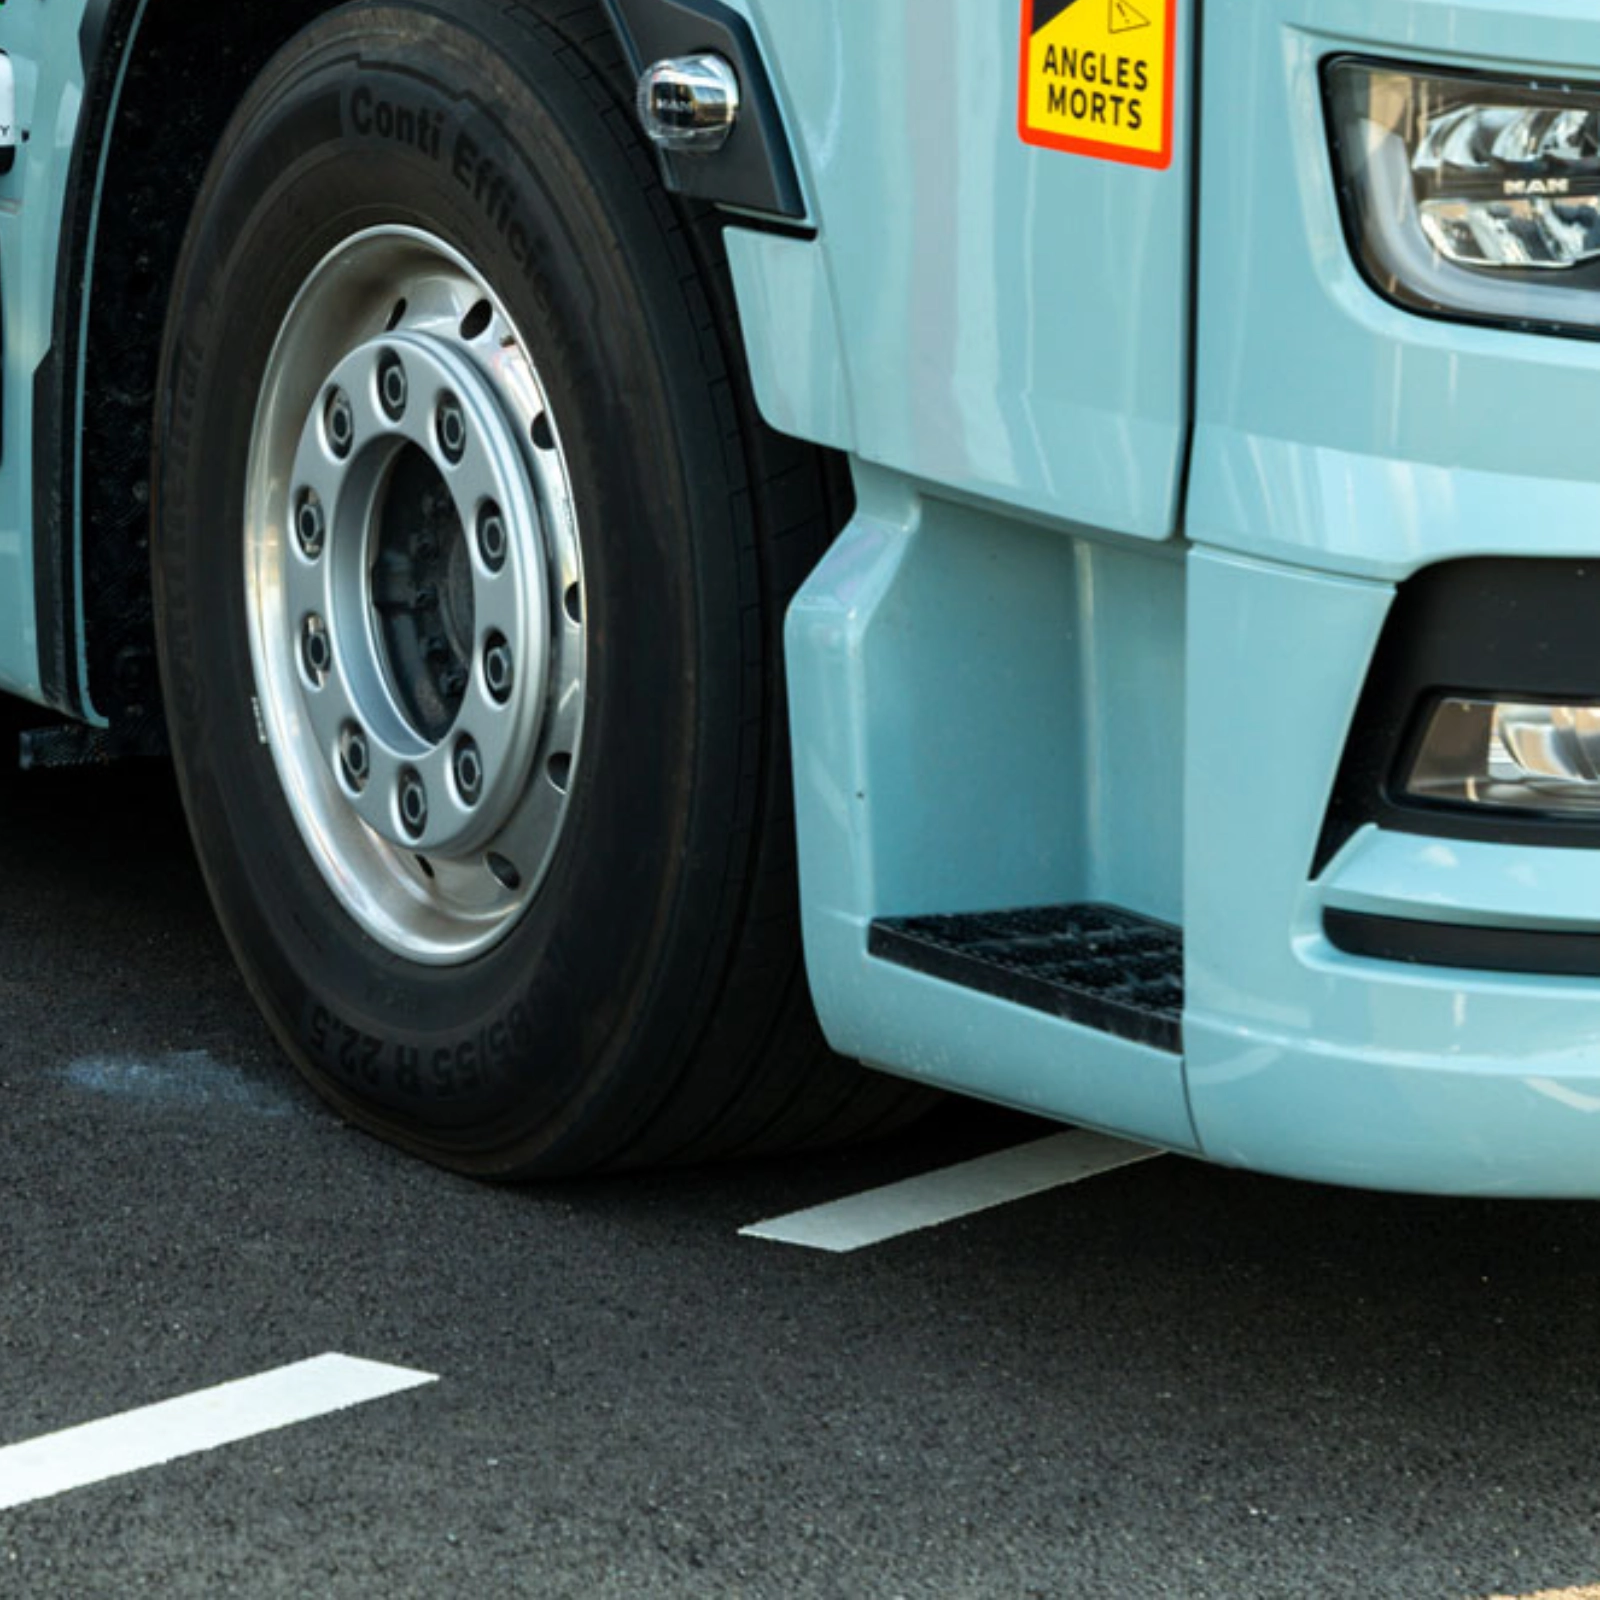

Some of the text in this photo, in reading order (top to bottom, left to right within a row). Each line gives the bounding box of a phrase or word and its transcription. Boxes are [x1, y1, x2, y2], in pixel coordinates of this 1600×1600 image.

[1042, 43, 1149, 92] ANGLES
[349, 84, 444, 161] Conti
[1046, 81, 1143, 131] MORTS
[1502, 177, 1570, 196] MAN
